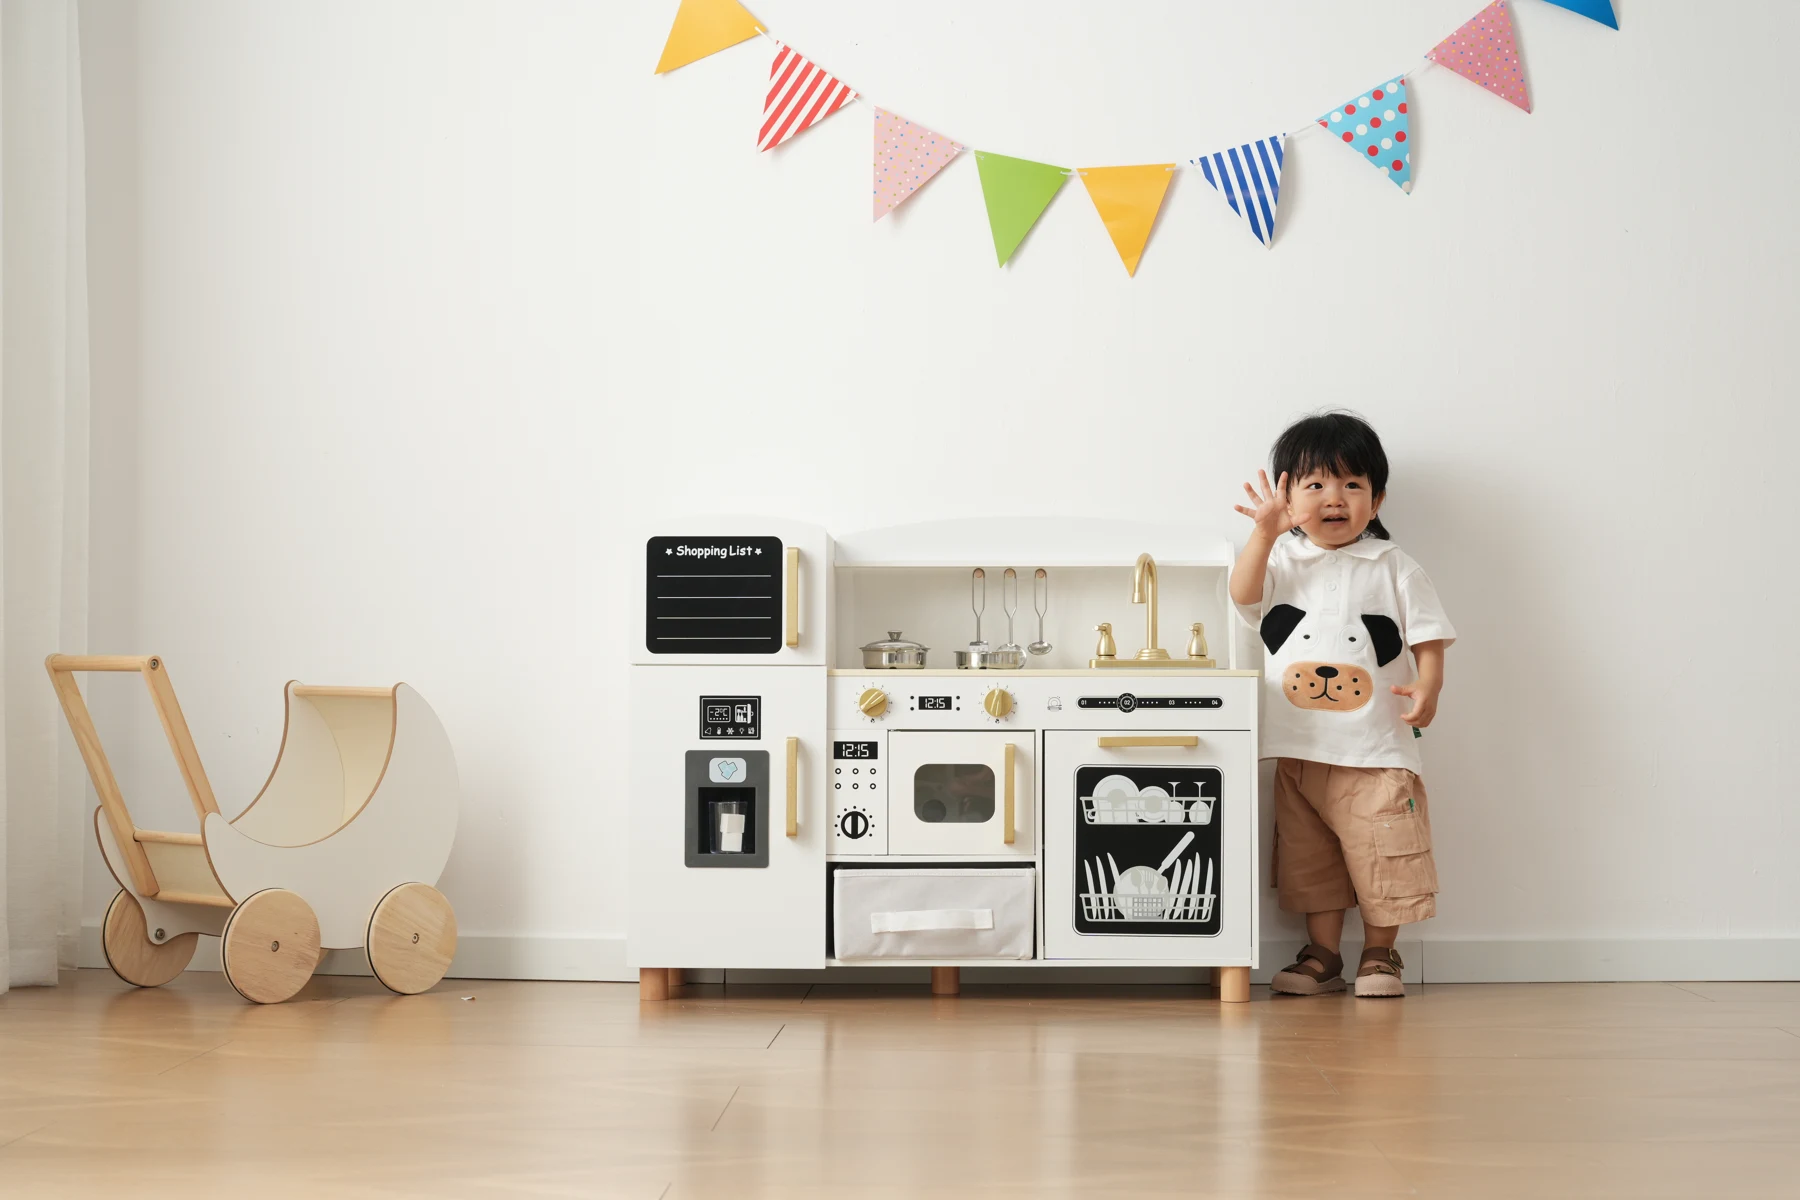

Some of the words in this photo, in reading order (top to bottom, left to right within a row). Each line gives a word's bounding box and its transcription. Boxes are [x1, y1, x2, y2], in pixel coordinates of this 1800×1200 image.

[676, 545, 727, 559] Shopping
[729, 545, 753, 556] List
[925, 698, 945, 708] 12:15
[842, 743, 869, 757] 12:15
